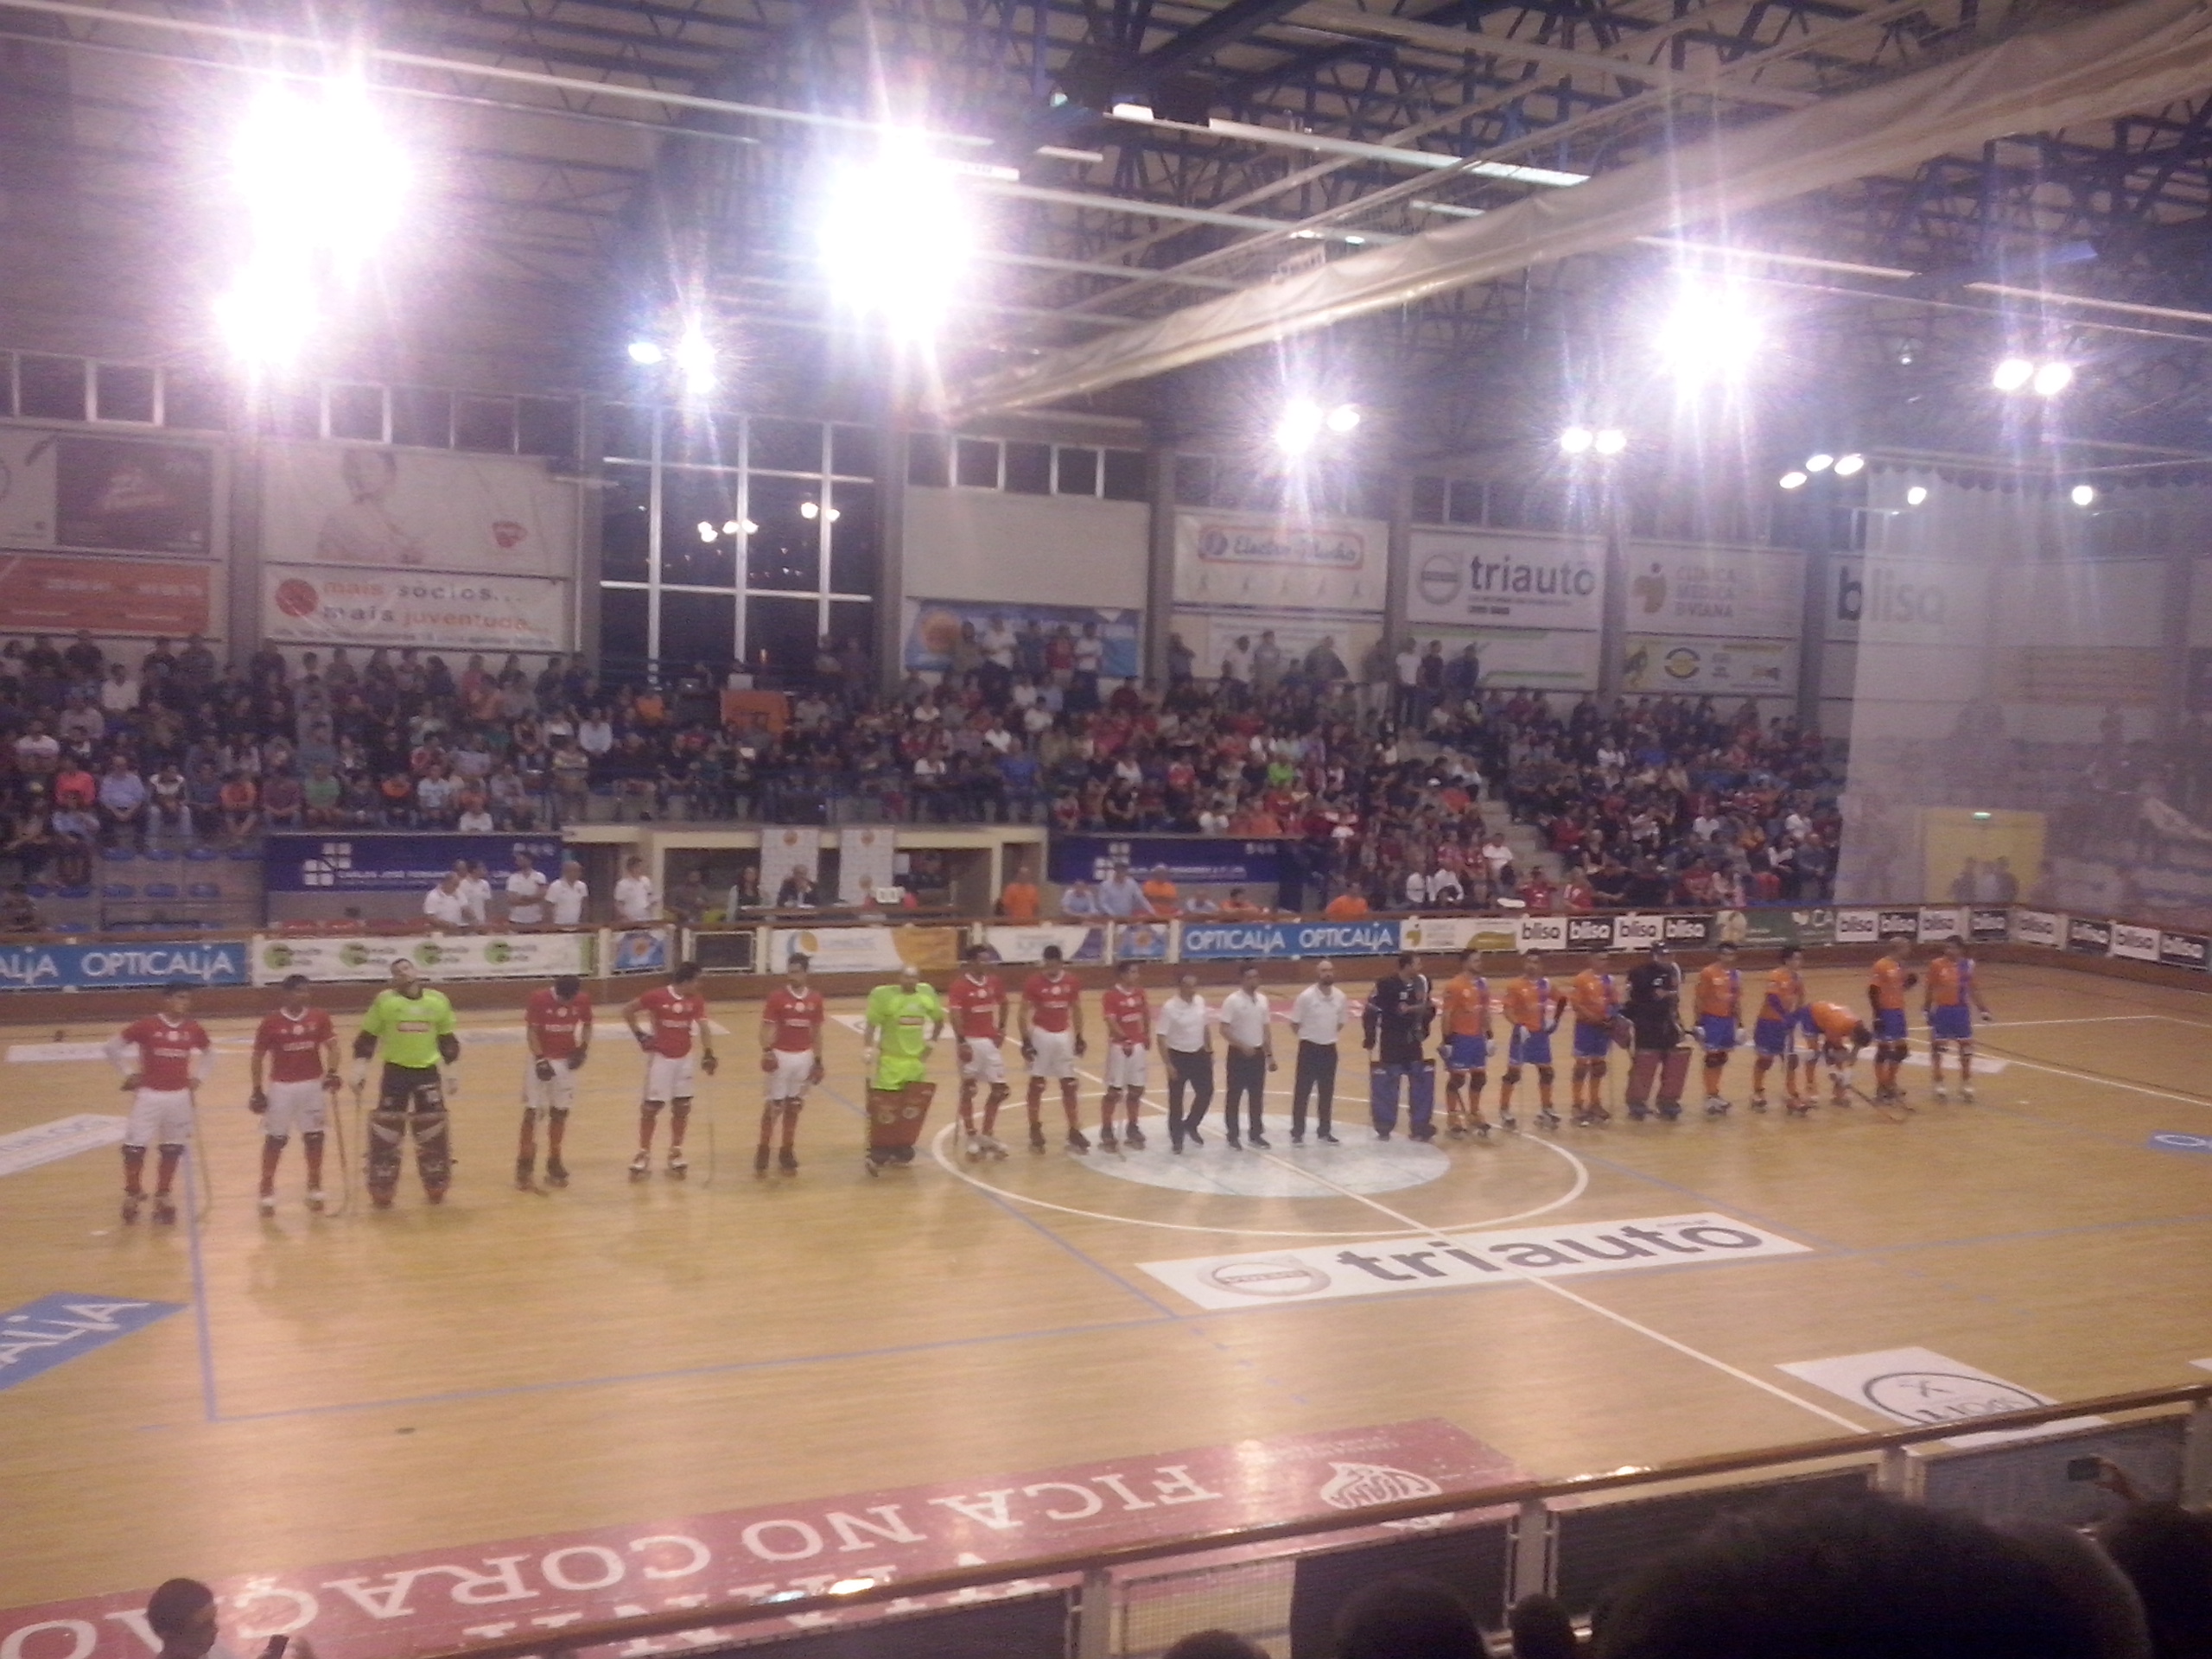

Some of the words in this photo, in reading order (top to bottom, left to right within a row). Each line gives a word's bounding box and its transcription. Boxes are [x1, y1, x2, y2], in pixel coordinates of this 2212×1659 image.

[1471, 555, 1596, 595] triauto
[1337, 1225, 1763, 1282] triauto
[928, 1464, 1224, 1531] FICA
[741, 1503, 927, 1562] NO
